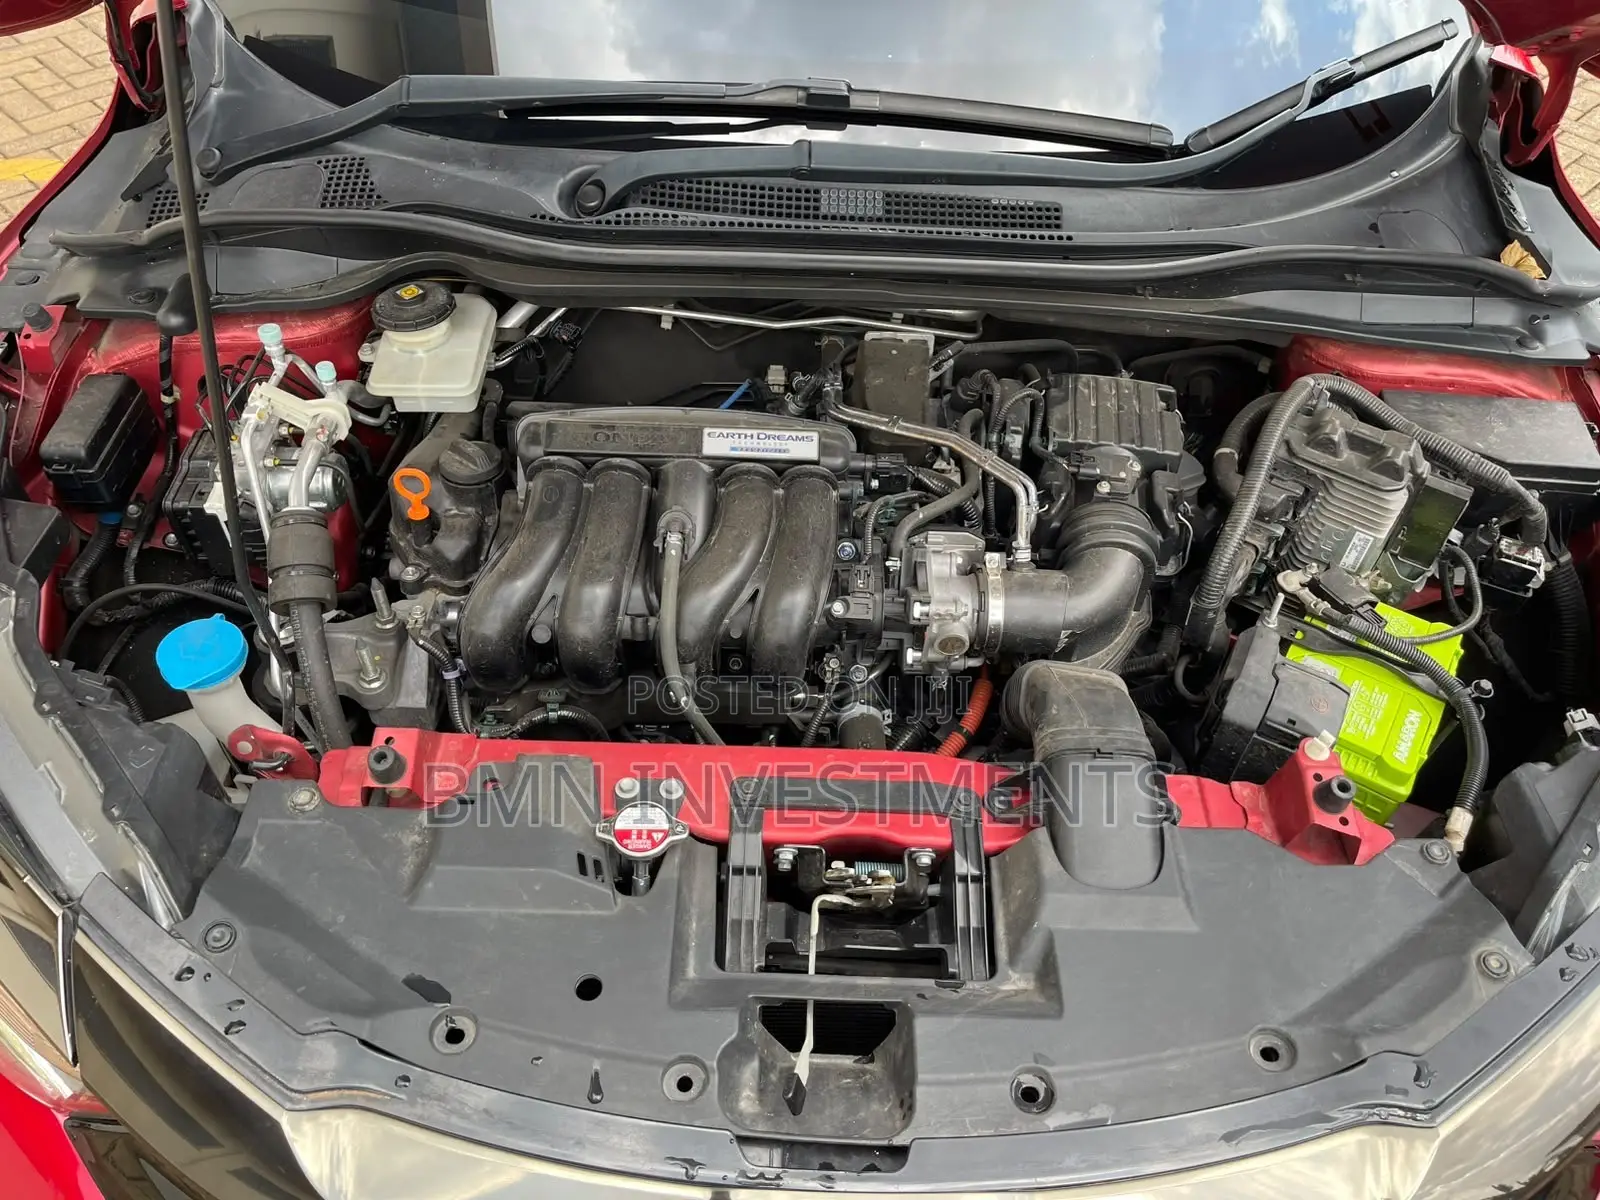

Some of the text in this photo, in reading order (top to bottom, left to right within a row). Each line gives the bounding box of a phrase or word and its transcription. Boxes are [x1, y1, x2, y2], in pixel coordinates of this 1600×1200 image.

[707, 431, 814, 442] EARTH DREAMS
[1393, 708, 1423, 765] AMARON
